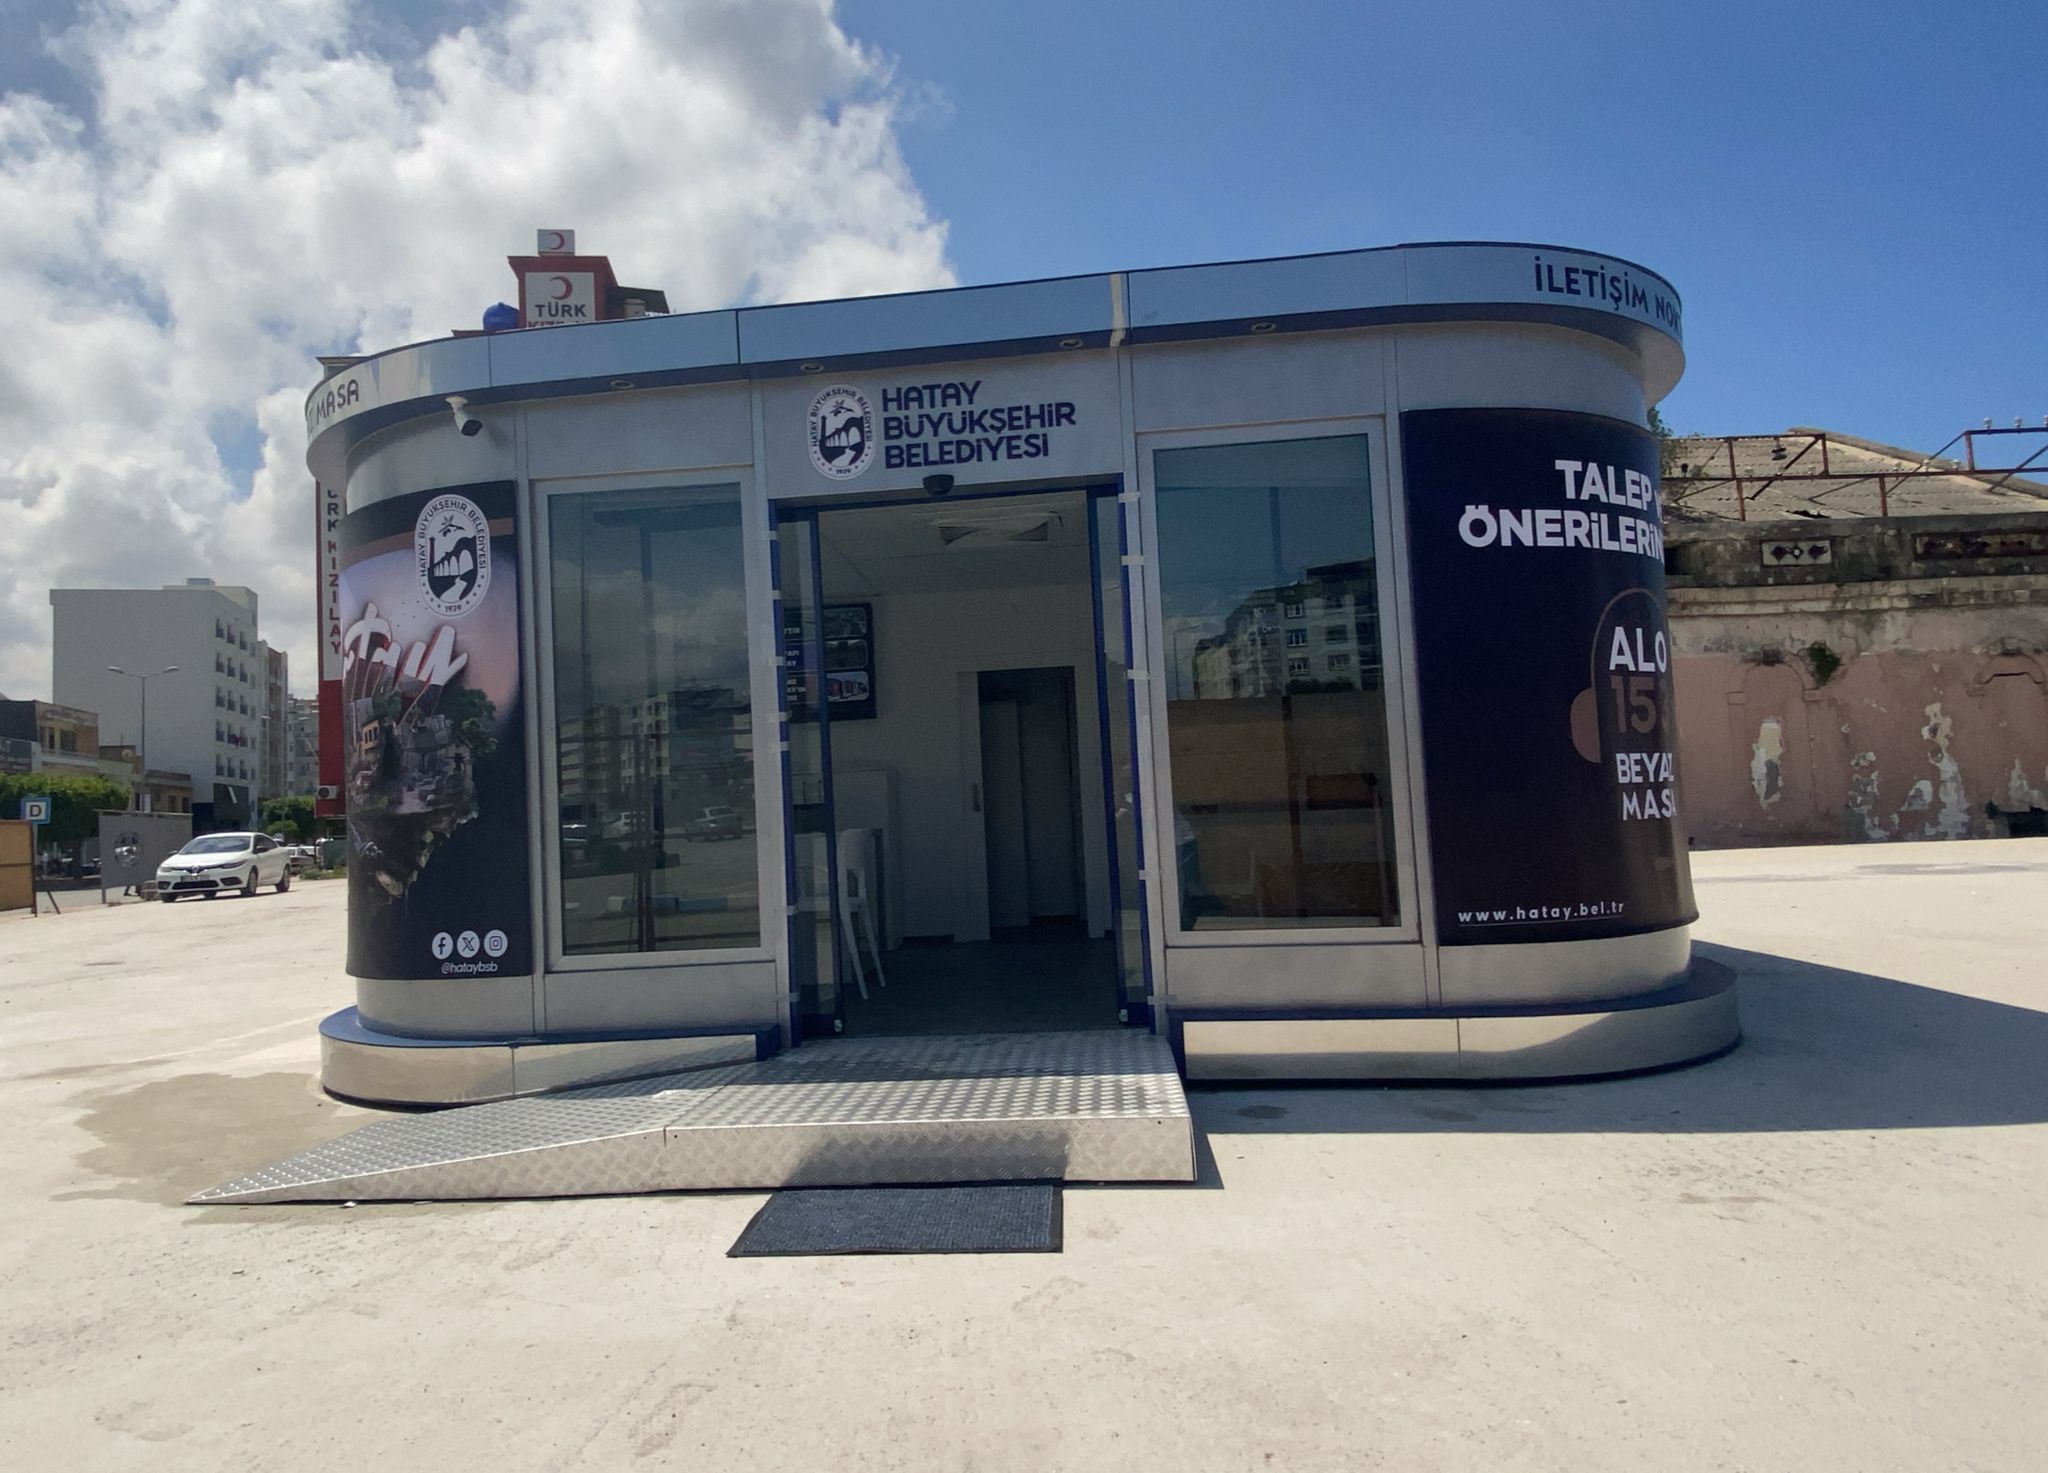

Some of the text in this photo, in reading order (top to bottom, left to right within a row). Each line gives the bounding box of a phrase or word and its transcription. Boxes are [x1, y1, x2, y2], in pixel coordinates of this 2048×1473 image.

[1534, 256, 1649, 312] İLETİŞİM
[534, 301, 587, 318] TÜRK
[316, 378, 360, 425] MASA
[881, 380, 983, 412] HATAY
[883, 401, 1077, 441] BÜYÜKŞEHİR
[885, 433, 1050, 469] BELEDİYESİ
[1554, 459, 1652, 511] TALEP
[1609, 626, 1668, 673] ALO
[29, 803, 43, 817] D
[1458, 901, 1625, 922] www.hatay.bel.tr
